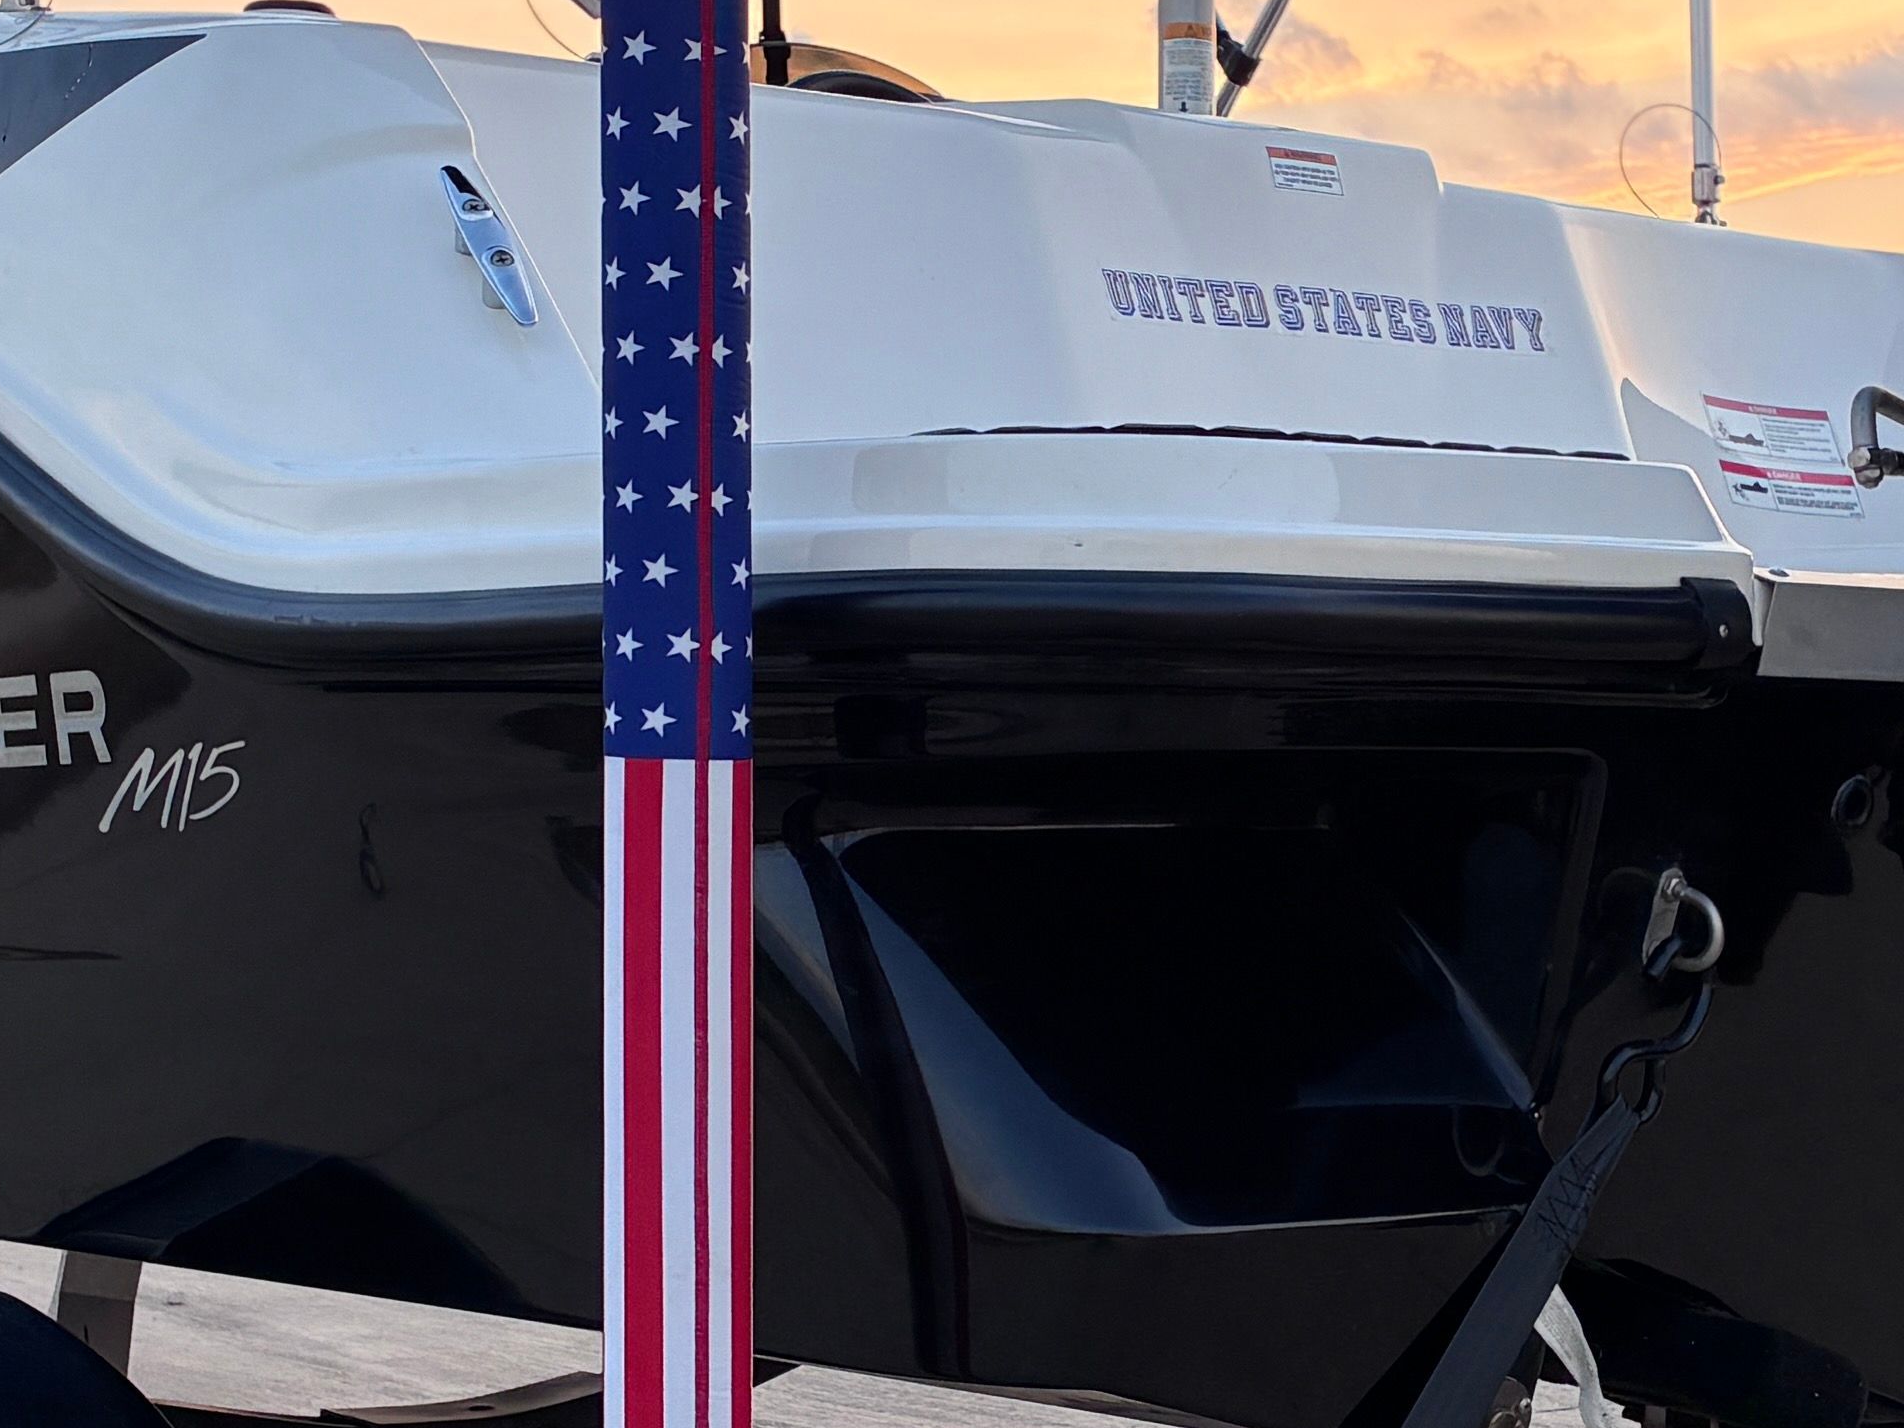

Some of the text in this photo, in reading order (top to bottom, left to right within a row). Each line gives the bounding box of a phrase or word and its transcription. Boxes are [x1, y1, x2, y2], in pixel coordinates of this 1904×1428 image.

[1102, 268, 1546, 353] UNITED STATES NAVY
[98, 740, 246, 834] M15
